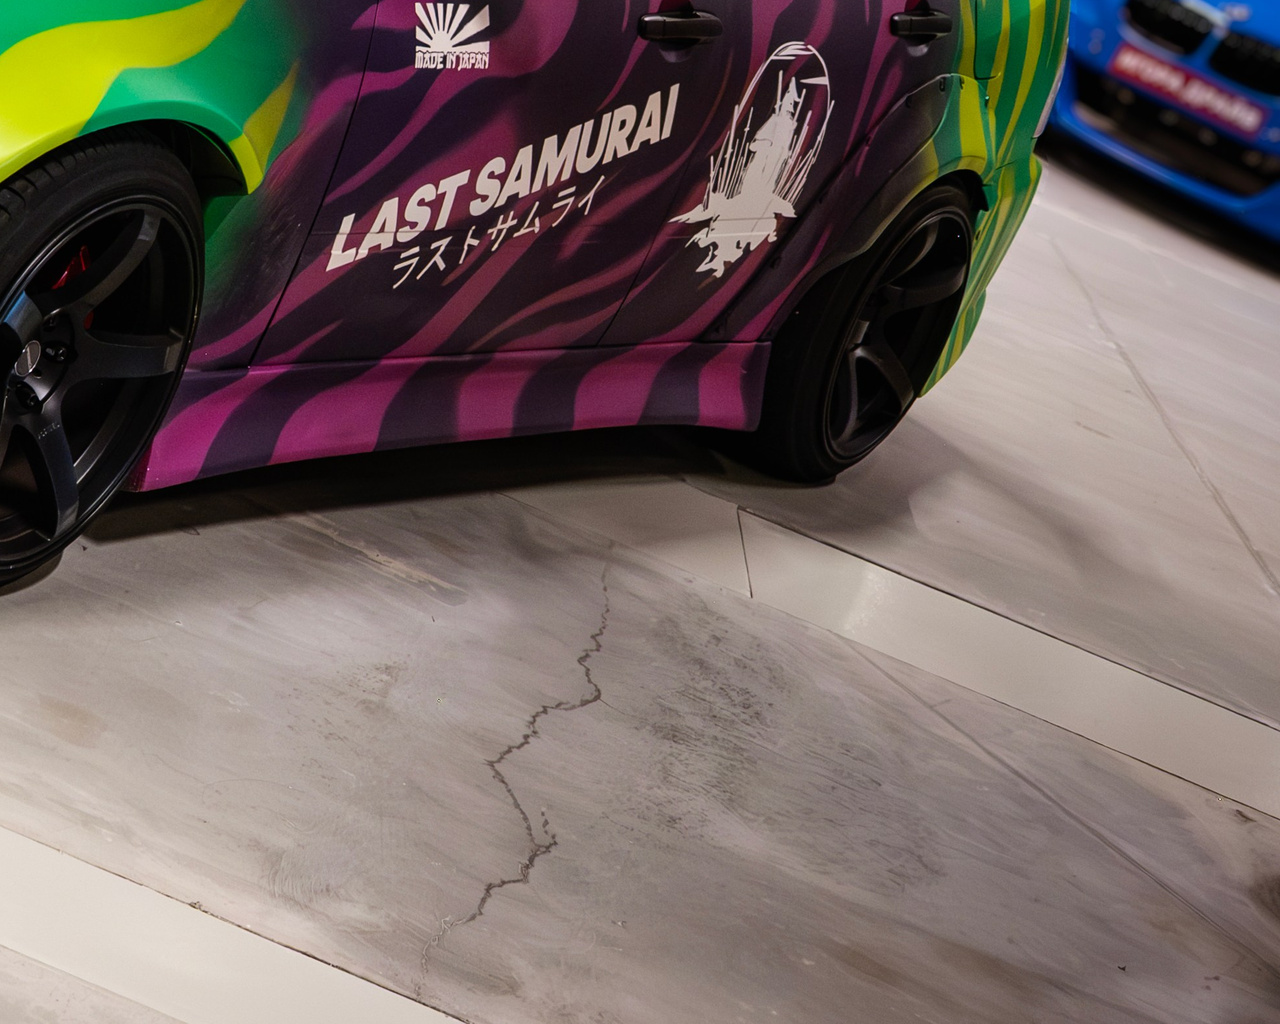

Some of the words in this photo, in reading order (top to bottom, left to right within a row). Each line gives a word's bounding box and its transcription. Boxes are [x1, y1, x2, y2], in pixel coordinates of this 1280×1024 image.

[415, 51, 444, 70] MADE
[446, 51, 457, 69] IN
[457, 51, 490, 72] JAPAN
[325, 169, 472, 273] LAST
[468, 82, 681, 217] SAMURAI
[392, 174, 607, 290] ラストサムライ
